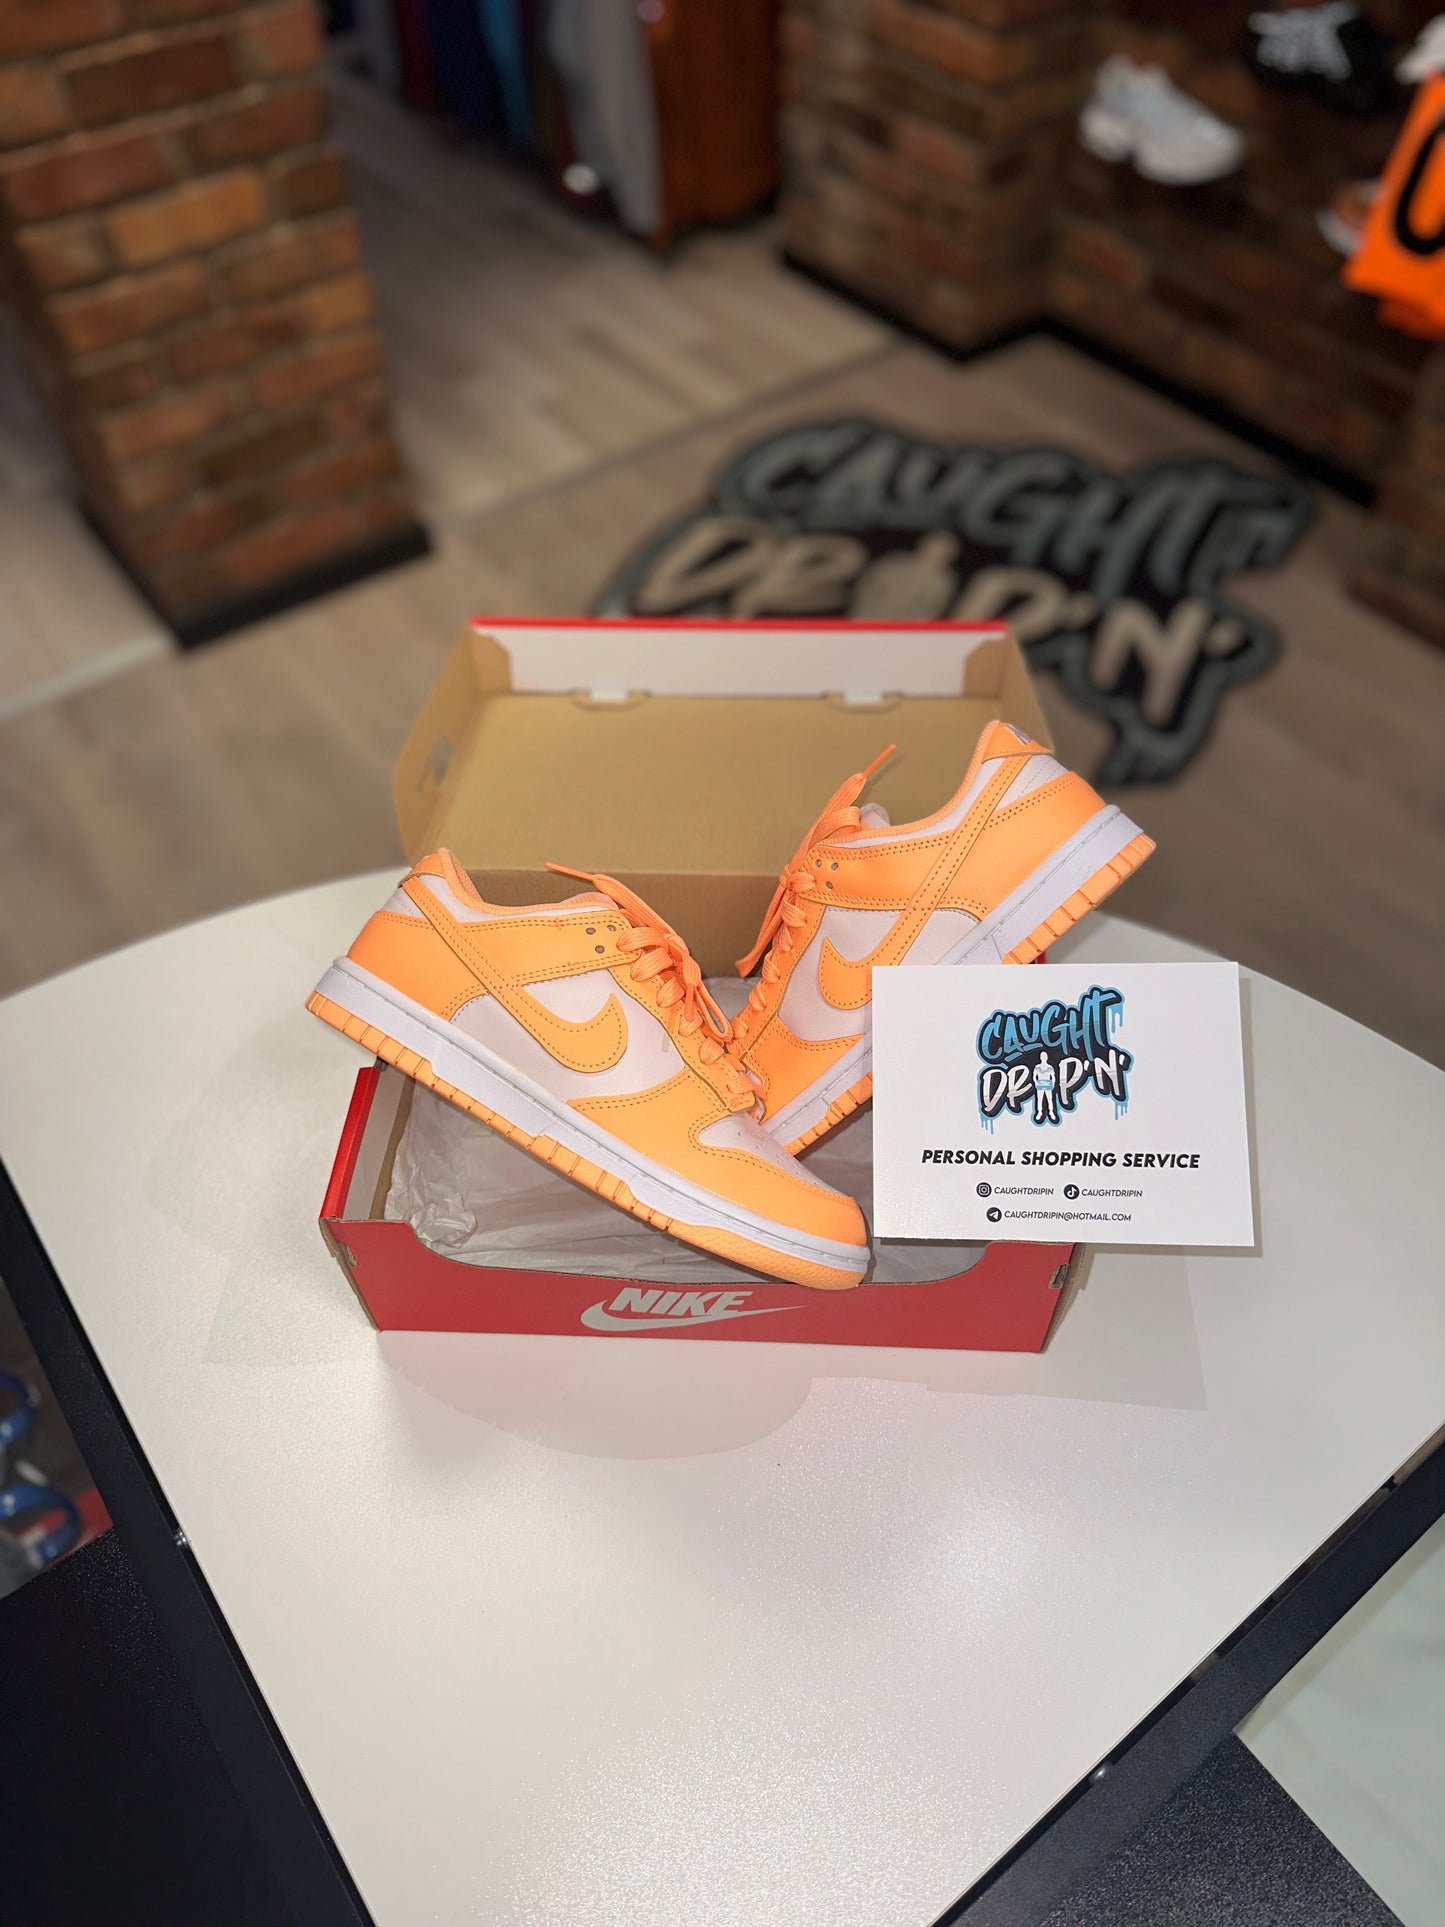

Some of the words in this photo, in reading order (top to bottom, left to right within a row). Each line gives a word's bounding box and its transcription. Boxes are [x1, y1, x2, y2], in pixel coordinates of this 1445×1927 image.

[740, 424, 1295, 602] CAUGHT
[981, 986, 1124, 1060] CAUGHT
[921, 1149, 1016, 1165] PERSONAL
[1020, 1151, 1117, 1167] SHOPPING
[1122, 1152, 1201, 1169] SERVICE
[993, 1186, 1055, 1196] CAUGHTDRIPIN
[1081, 1188, 1143, 1198] CAUGHTDRIPIN
[1004, 1210, 1132, 1222] CAUGHTDRIPIN@HOTMAIL.COM
[607, 1287, 754, 1317] NIKE
